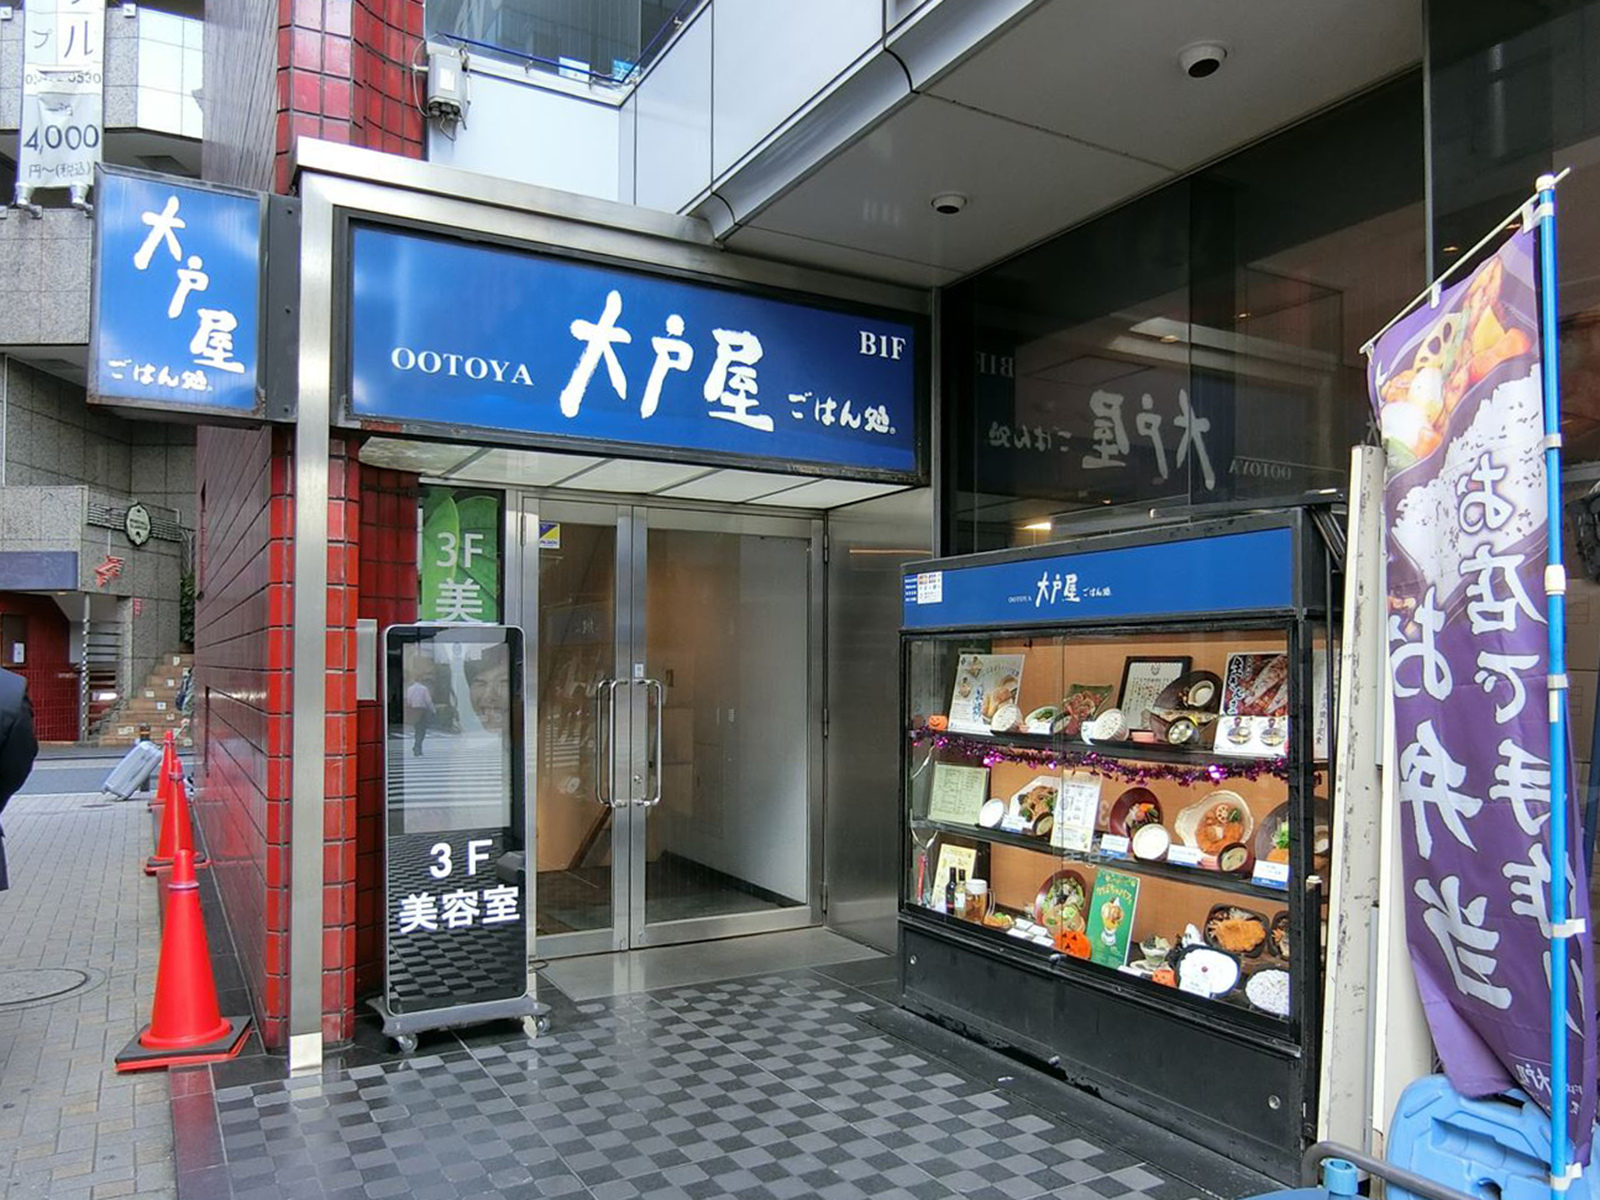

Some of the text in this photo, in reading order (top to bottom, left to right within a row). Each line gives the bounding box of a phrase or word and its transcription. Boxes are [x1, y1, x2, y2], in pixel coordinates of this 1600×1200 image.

[23, 123, 100, 155] 4,000
[133, 195, 245, 374] 大戸屋
[390, 346, 534, 387] OOTOYA
[559, 289, 775, 433] 大戸屋
[436, 531, 484, 568] 3F
[1035, 571, 1081, 608] 大戸屋
[399, 883, 520, 934] 美容室
